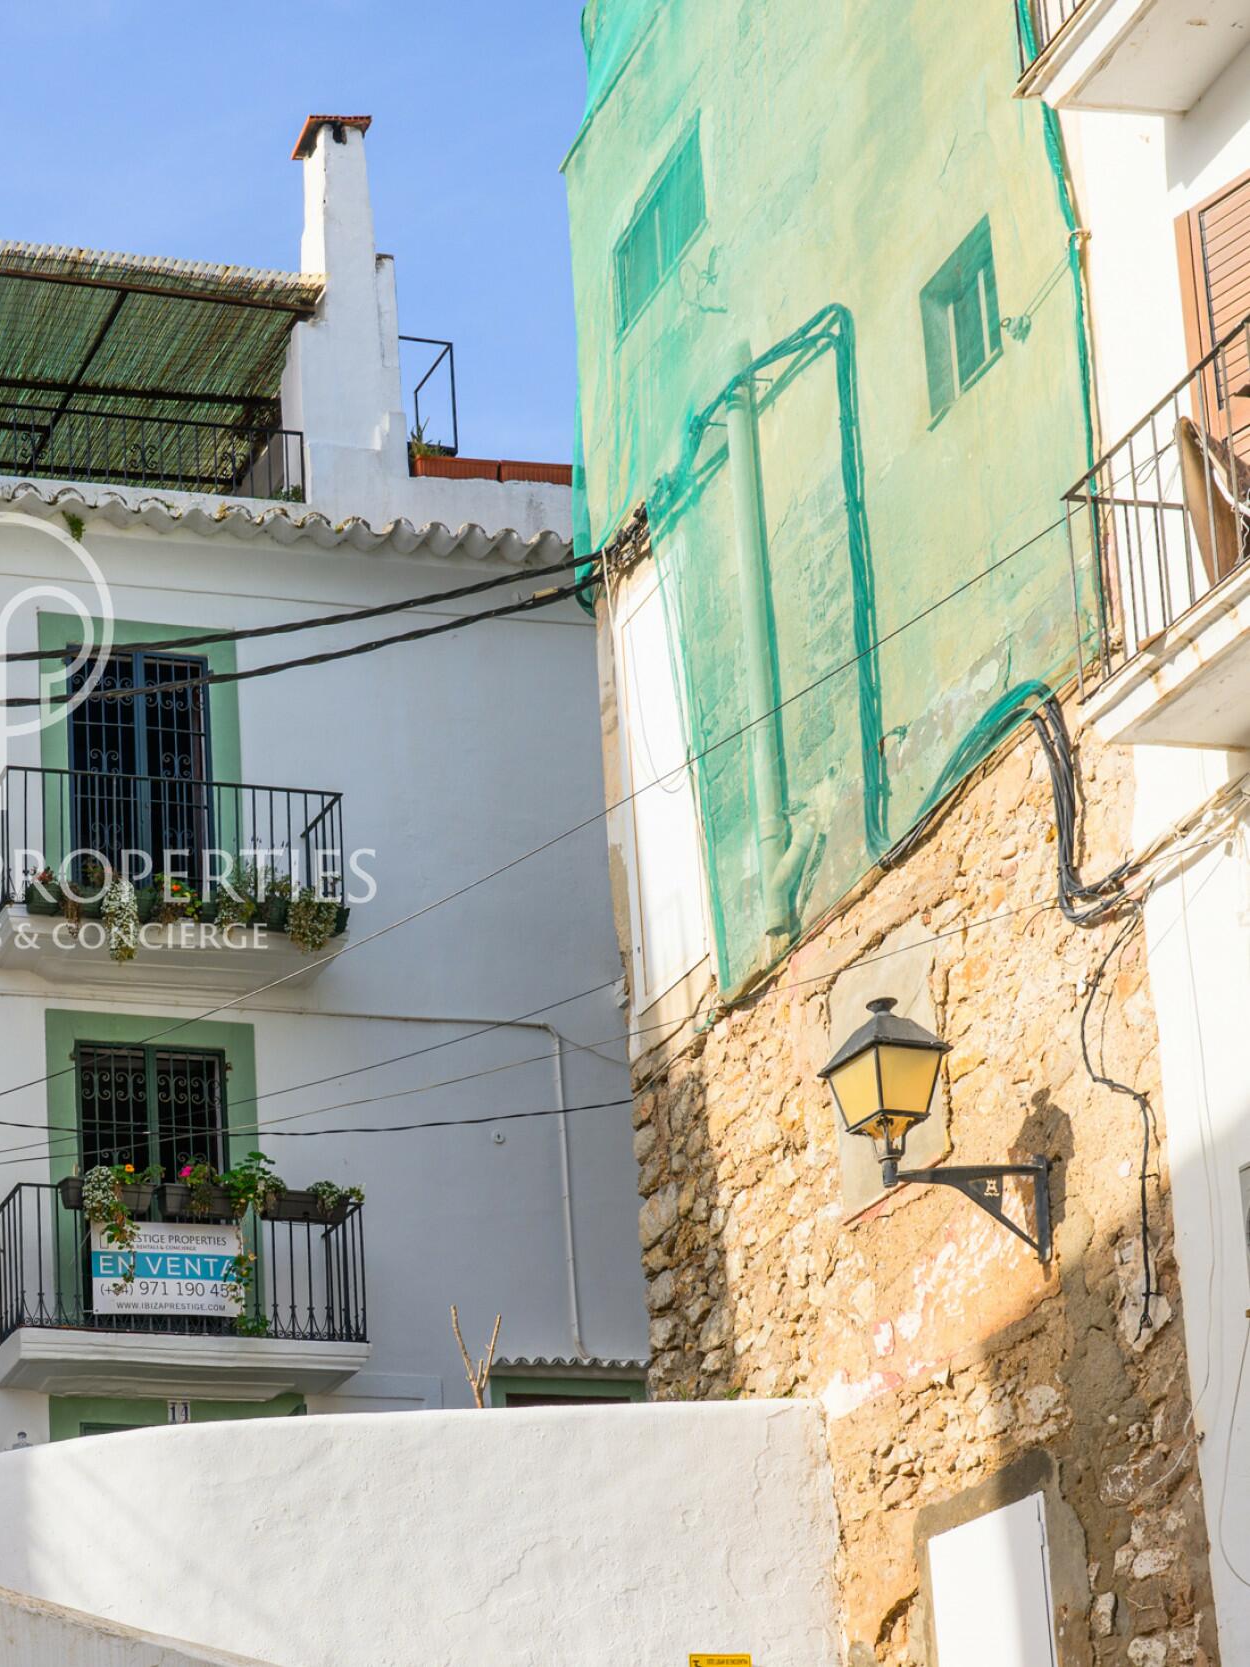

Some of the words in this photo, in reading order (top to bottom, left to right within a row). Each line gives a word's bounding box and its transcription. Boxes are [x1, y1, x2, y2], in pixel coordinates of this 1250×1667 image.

[168, 1234, 227, 1246] PROPERTIES
[100, 1255, 133, 1274] EN
[145, 1256, 237, 1278] VENTA
[139, 1281, 169, 1296] 971
[177, 1282, 205, 1297] 190
[116, 1301, 226, 1312] WWW.IBIZAPRESTIGE.COM
